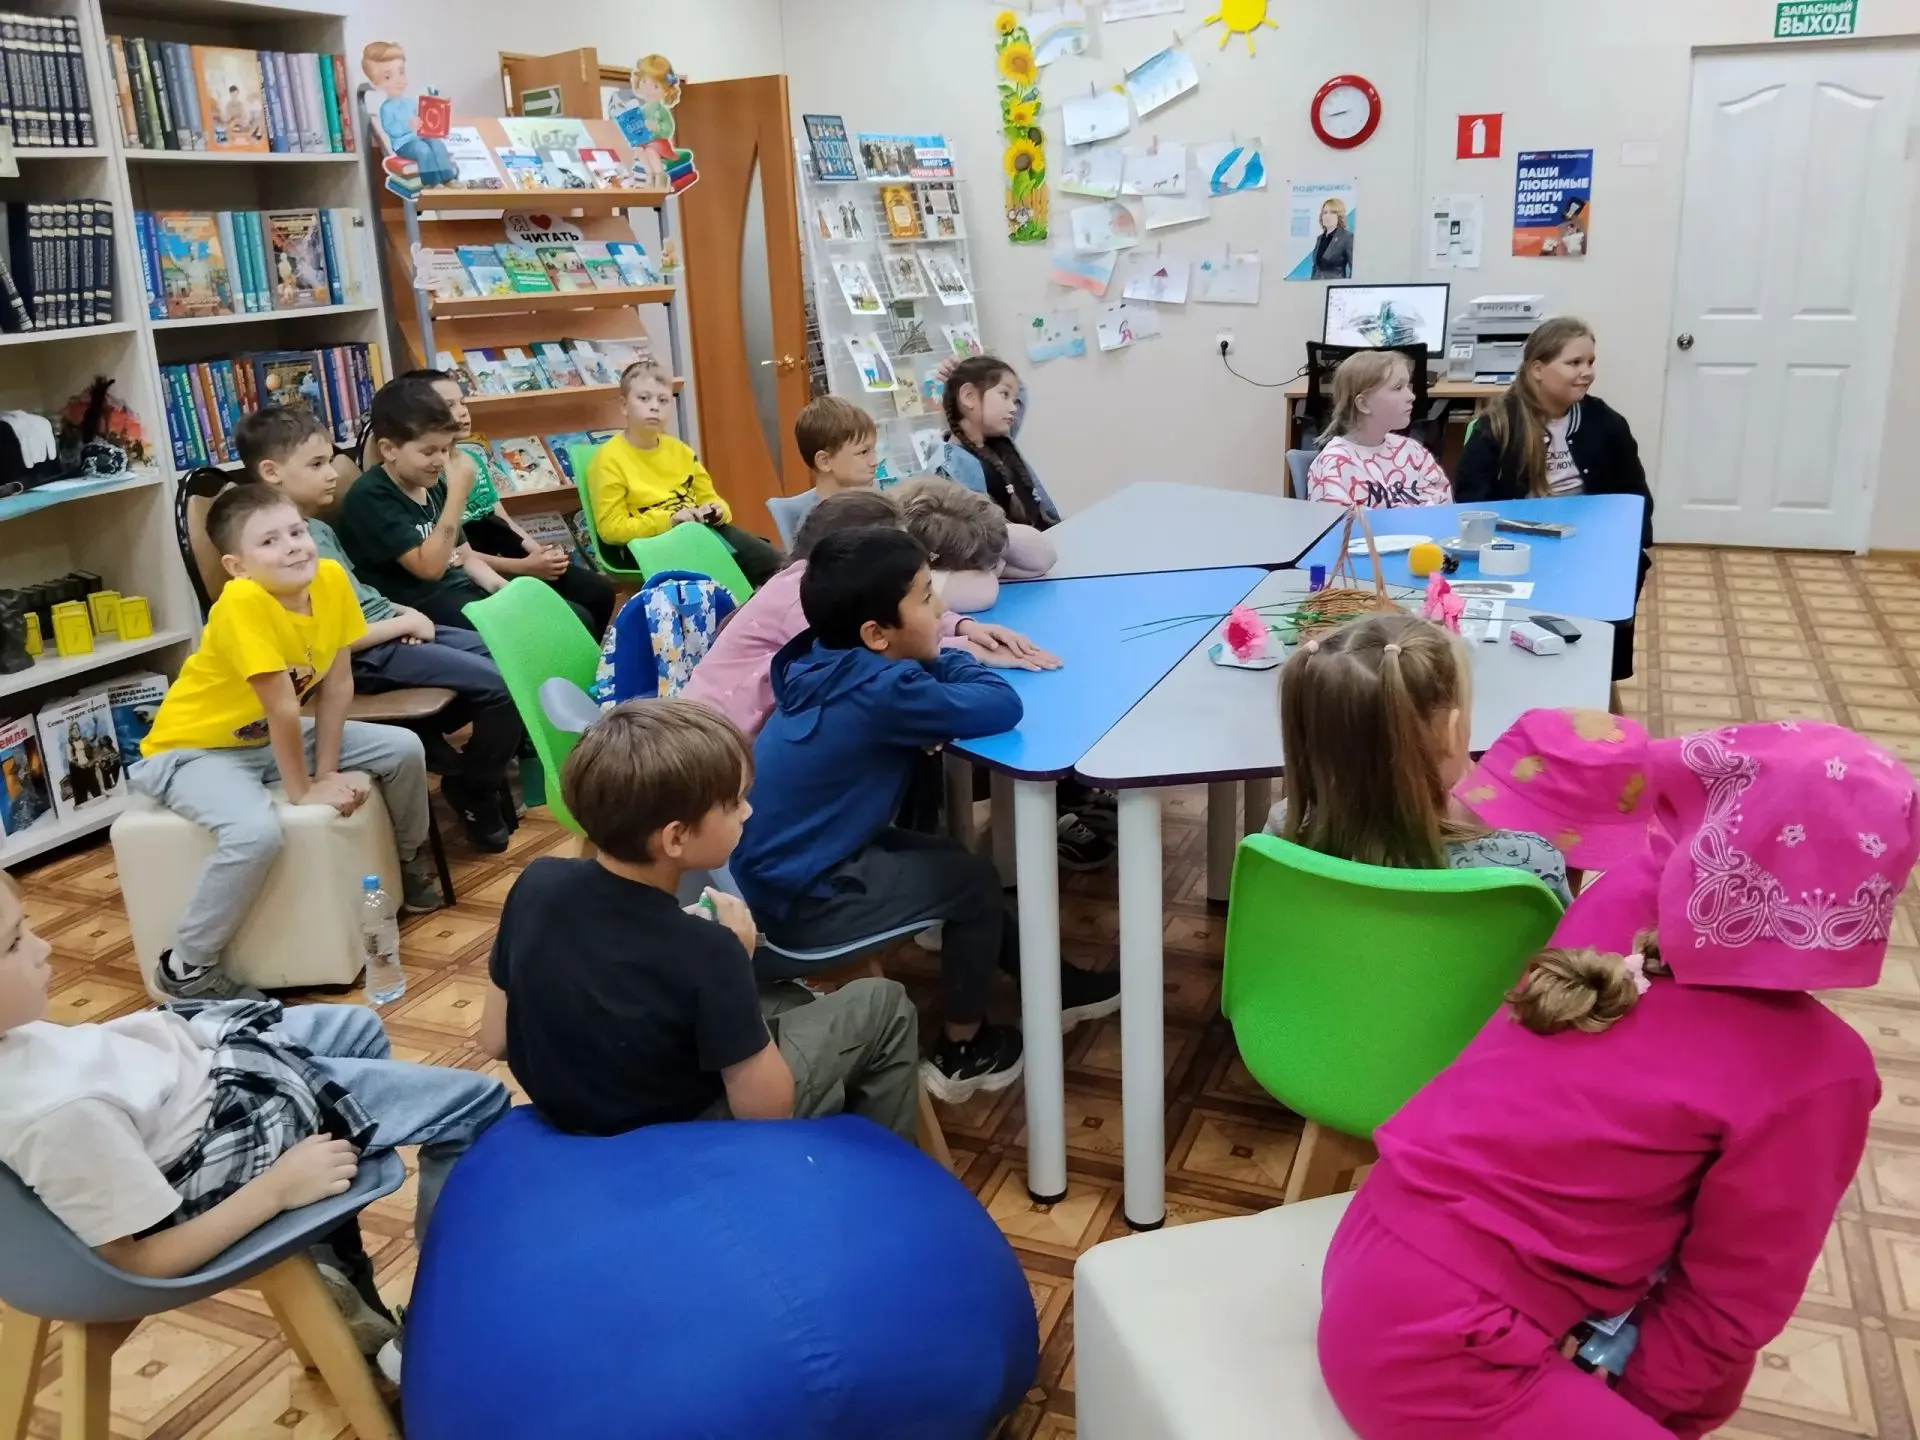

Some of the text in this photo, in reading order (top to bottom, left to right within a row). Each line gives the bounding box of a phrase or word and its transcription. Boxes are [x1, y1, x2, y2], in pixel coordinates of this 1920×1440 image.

[1781, 0, 1853, 16] ЗАПАСНЫЙ
[1778, 13, 1851, 35] ВЫХОД
[1519, 166, 1559, 179] ВАШИ
[1518, 177, 1589, 191] ЛЮБИМЫЕ
[1518, 190, 1563, 203] КНИГИ
[1517, 203, 1558, 217] ЗДЕСЬ
[508, 214, 530, 232] Я
[520, 231, 580, 243] ЧИТАТЬ
[0, 727, 27, 750] емля
